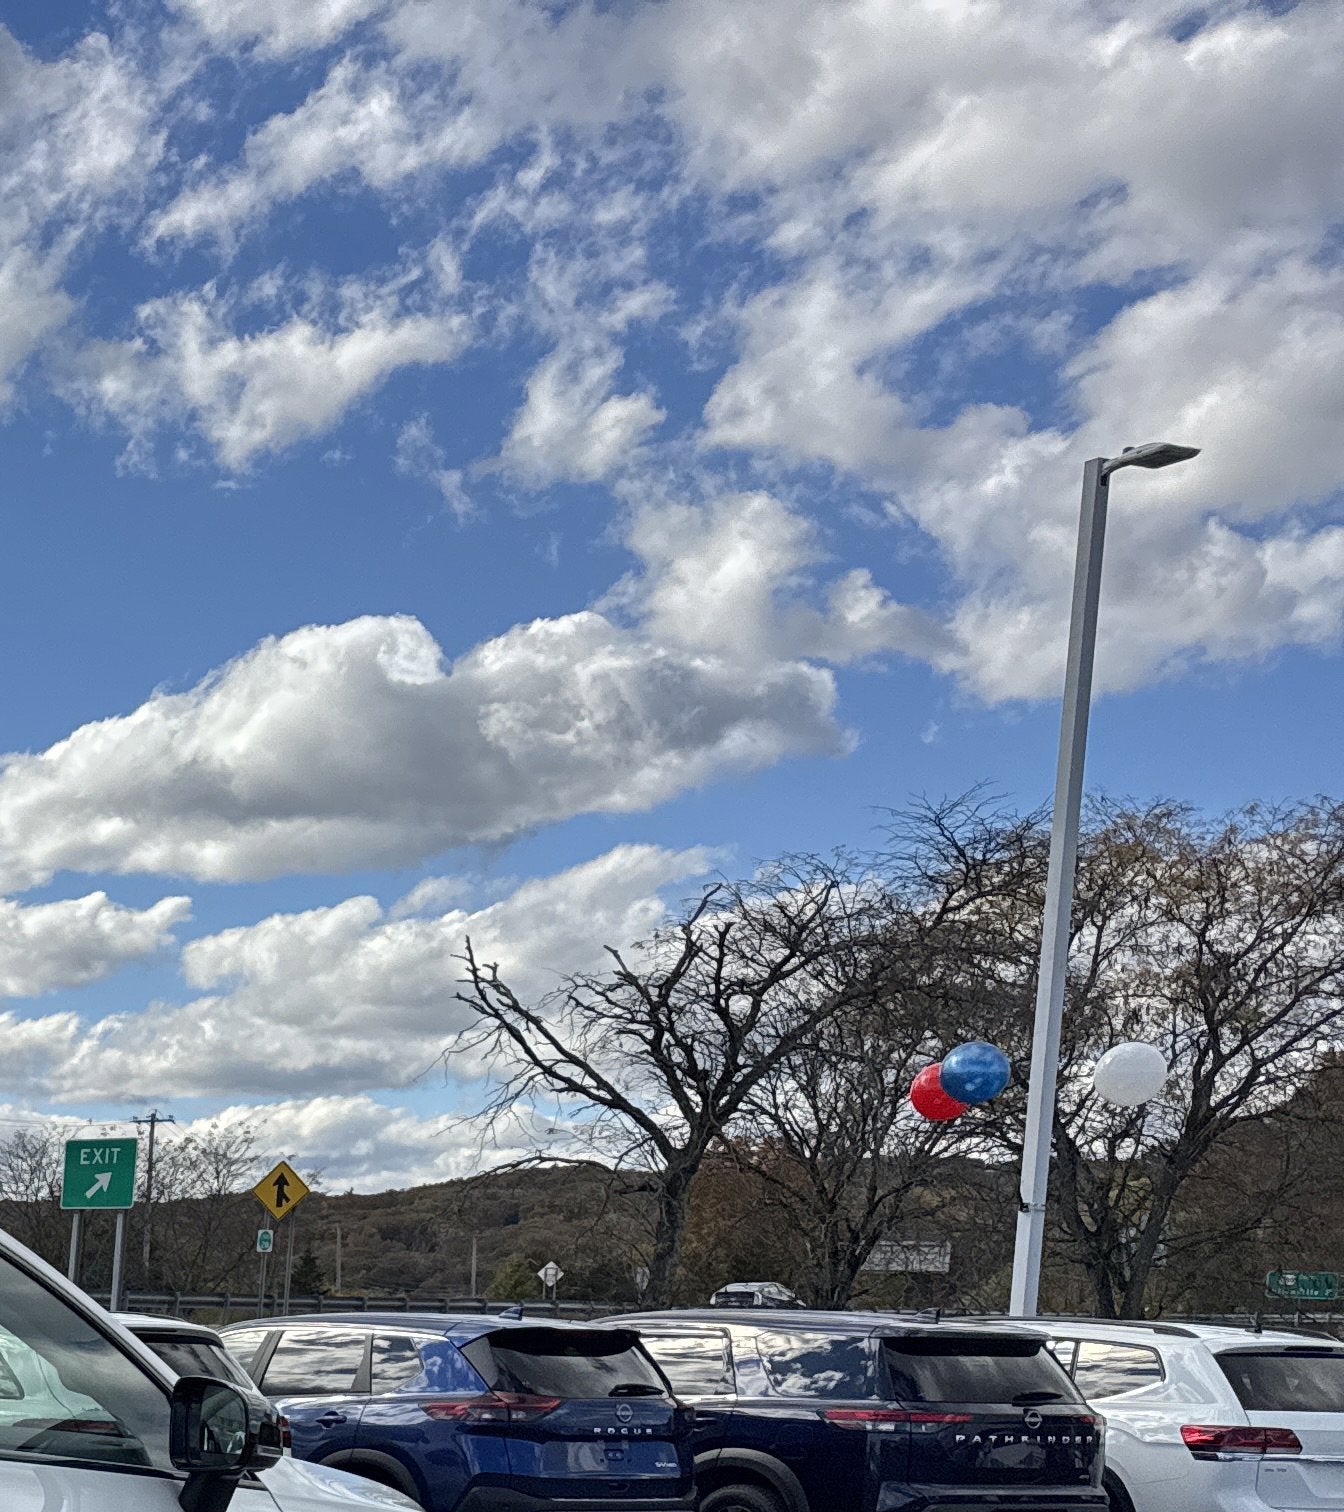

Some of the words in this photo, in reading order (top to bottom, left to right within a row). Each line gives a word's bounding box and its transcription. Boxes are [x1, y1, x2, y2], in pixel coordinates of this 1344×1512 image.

[79, 1147, 122, 1165] EXIT
[593, 1427, 653, 1435] ROGUE
[955, 1433, 1094, 1445] PATHFINDER
